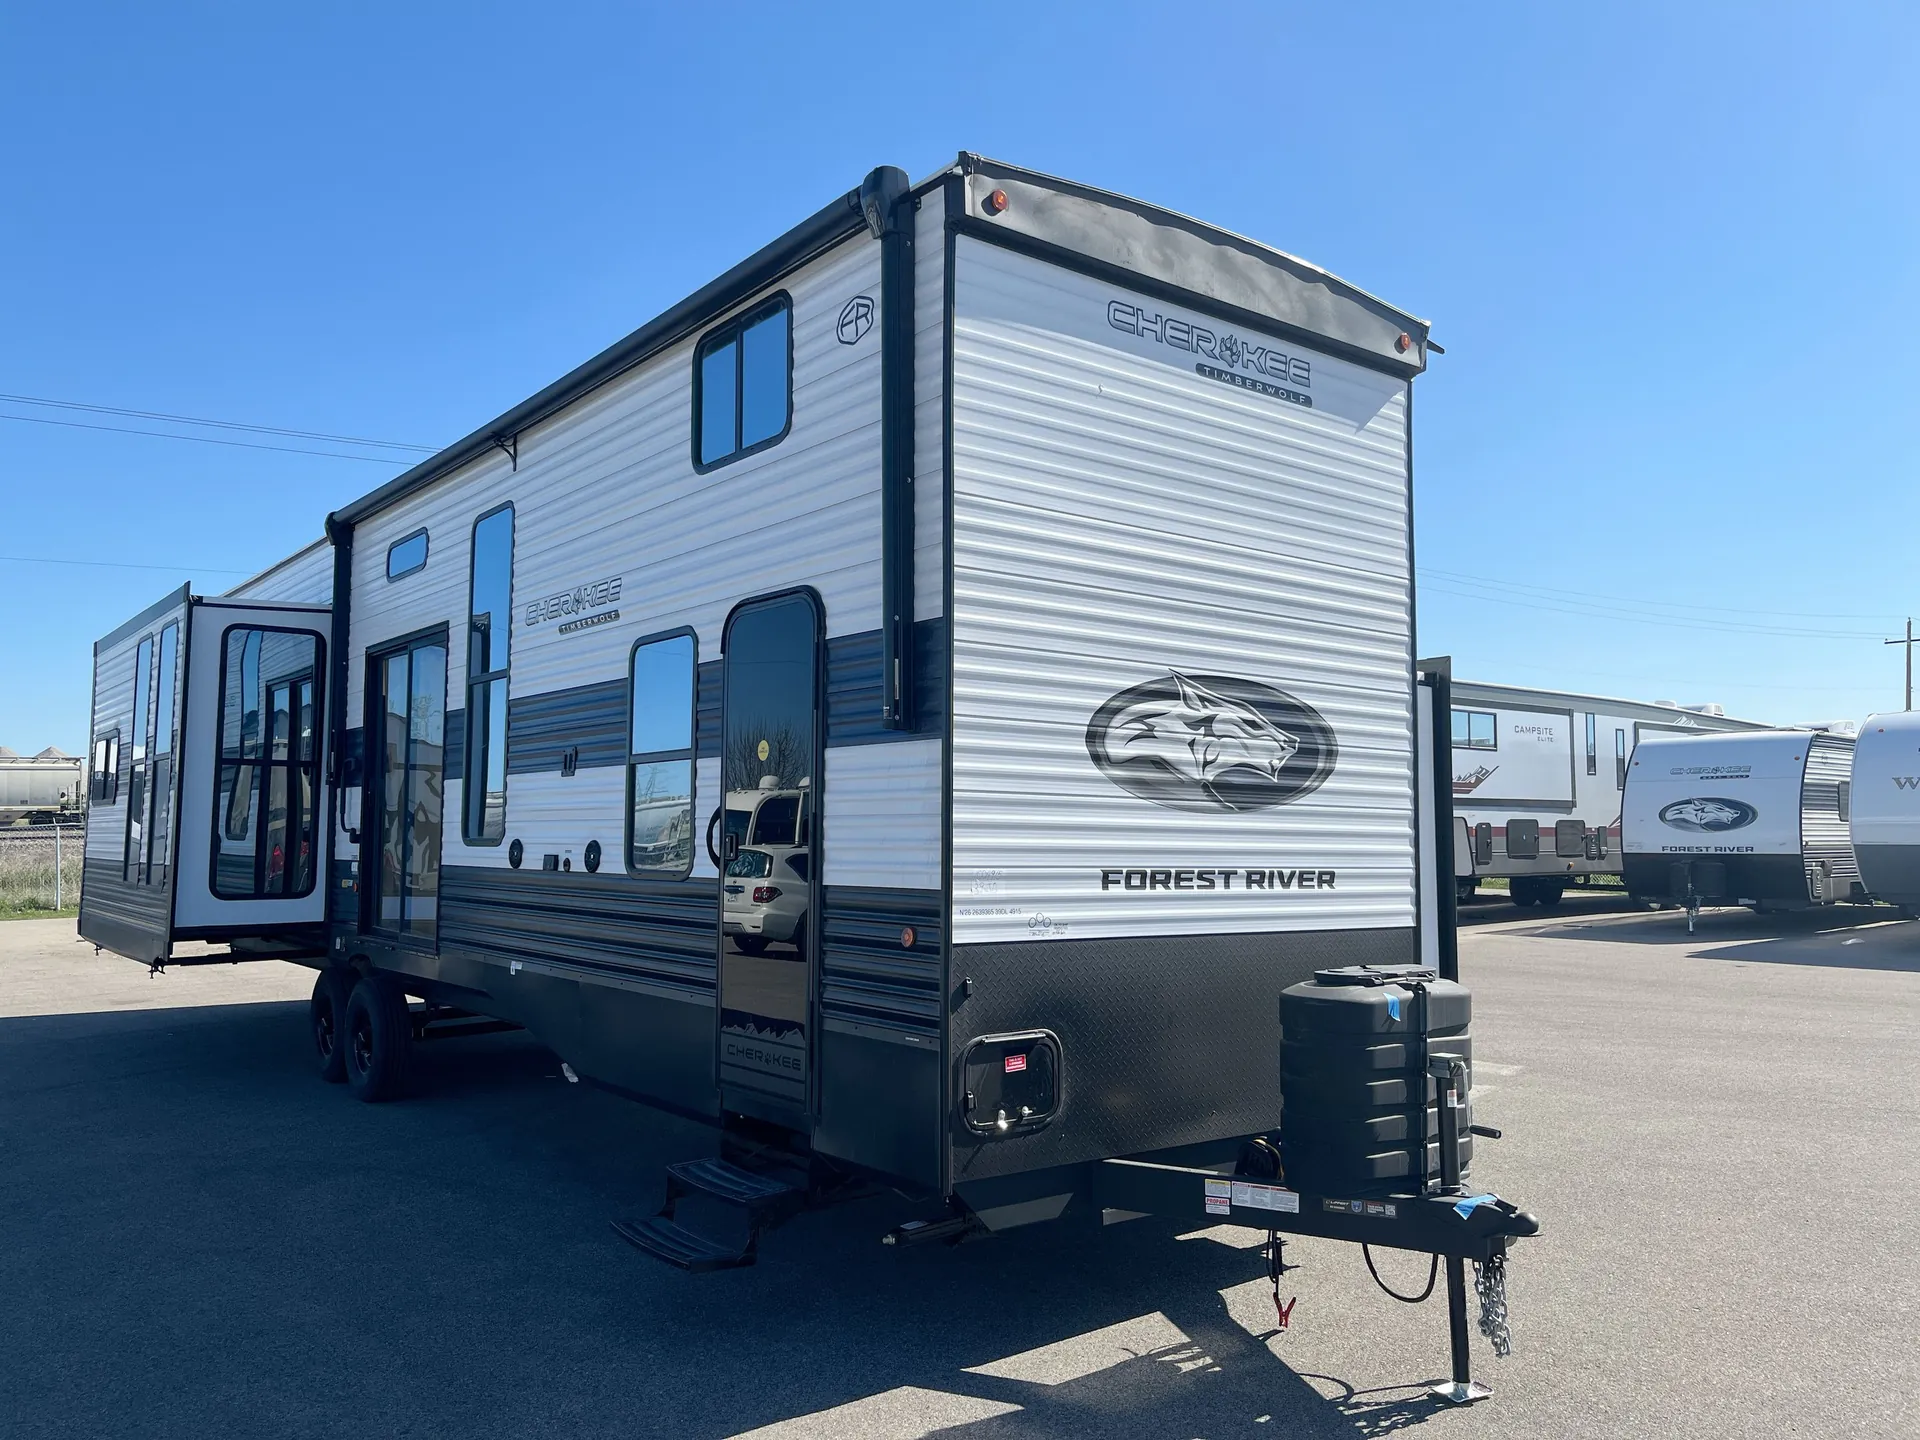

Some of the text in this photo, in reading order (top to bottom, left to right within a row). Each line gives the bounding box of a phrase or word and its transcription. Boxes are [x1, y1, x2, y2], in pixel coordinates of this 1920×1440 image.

[1203, 366, 1306, 404] TIMBERWOLF
[561, 612, 617, 632] TIMBERWOLF
[1514, 725, 1554, 736] CAMPSITE
[1662, 845, 1754, 853] FOREST RIVER
[1100, 869, 1336, 890] FOREST RIVER
